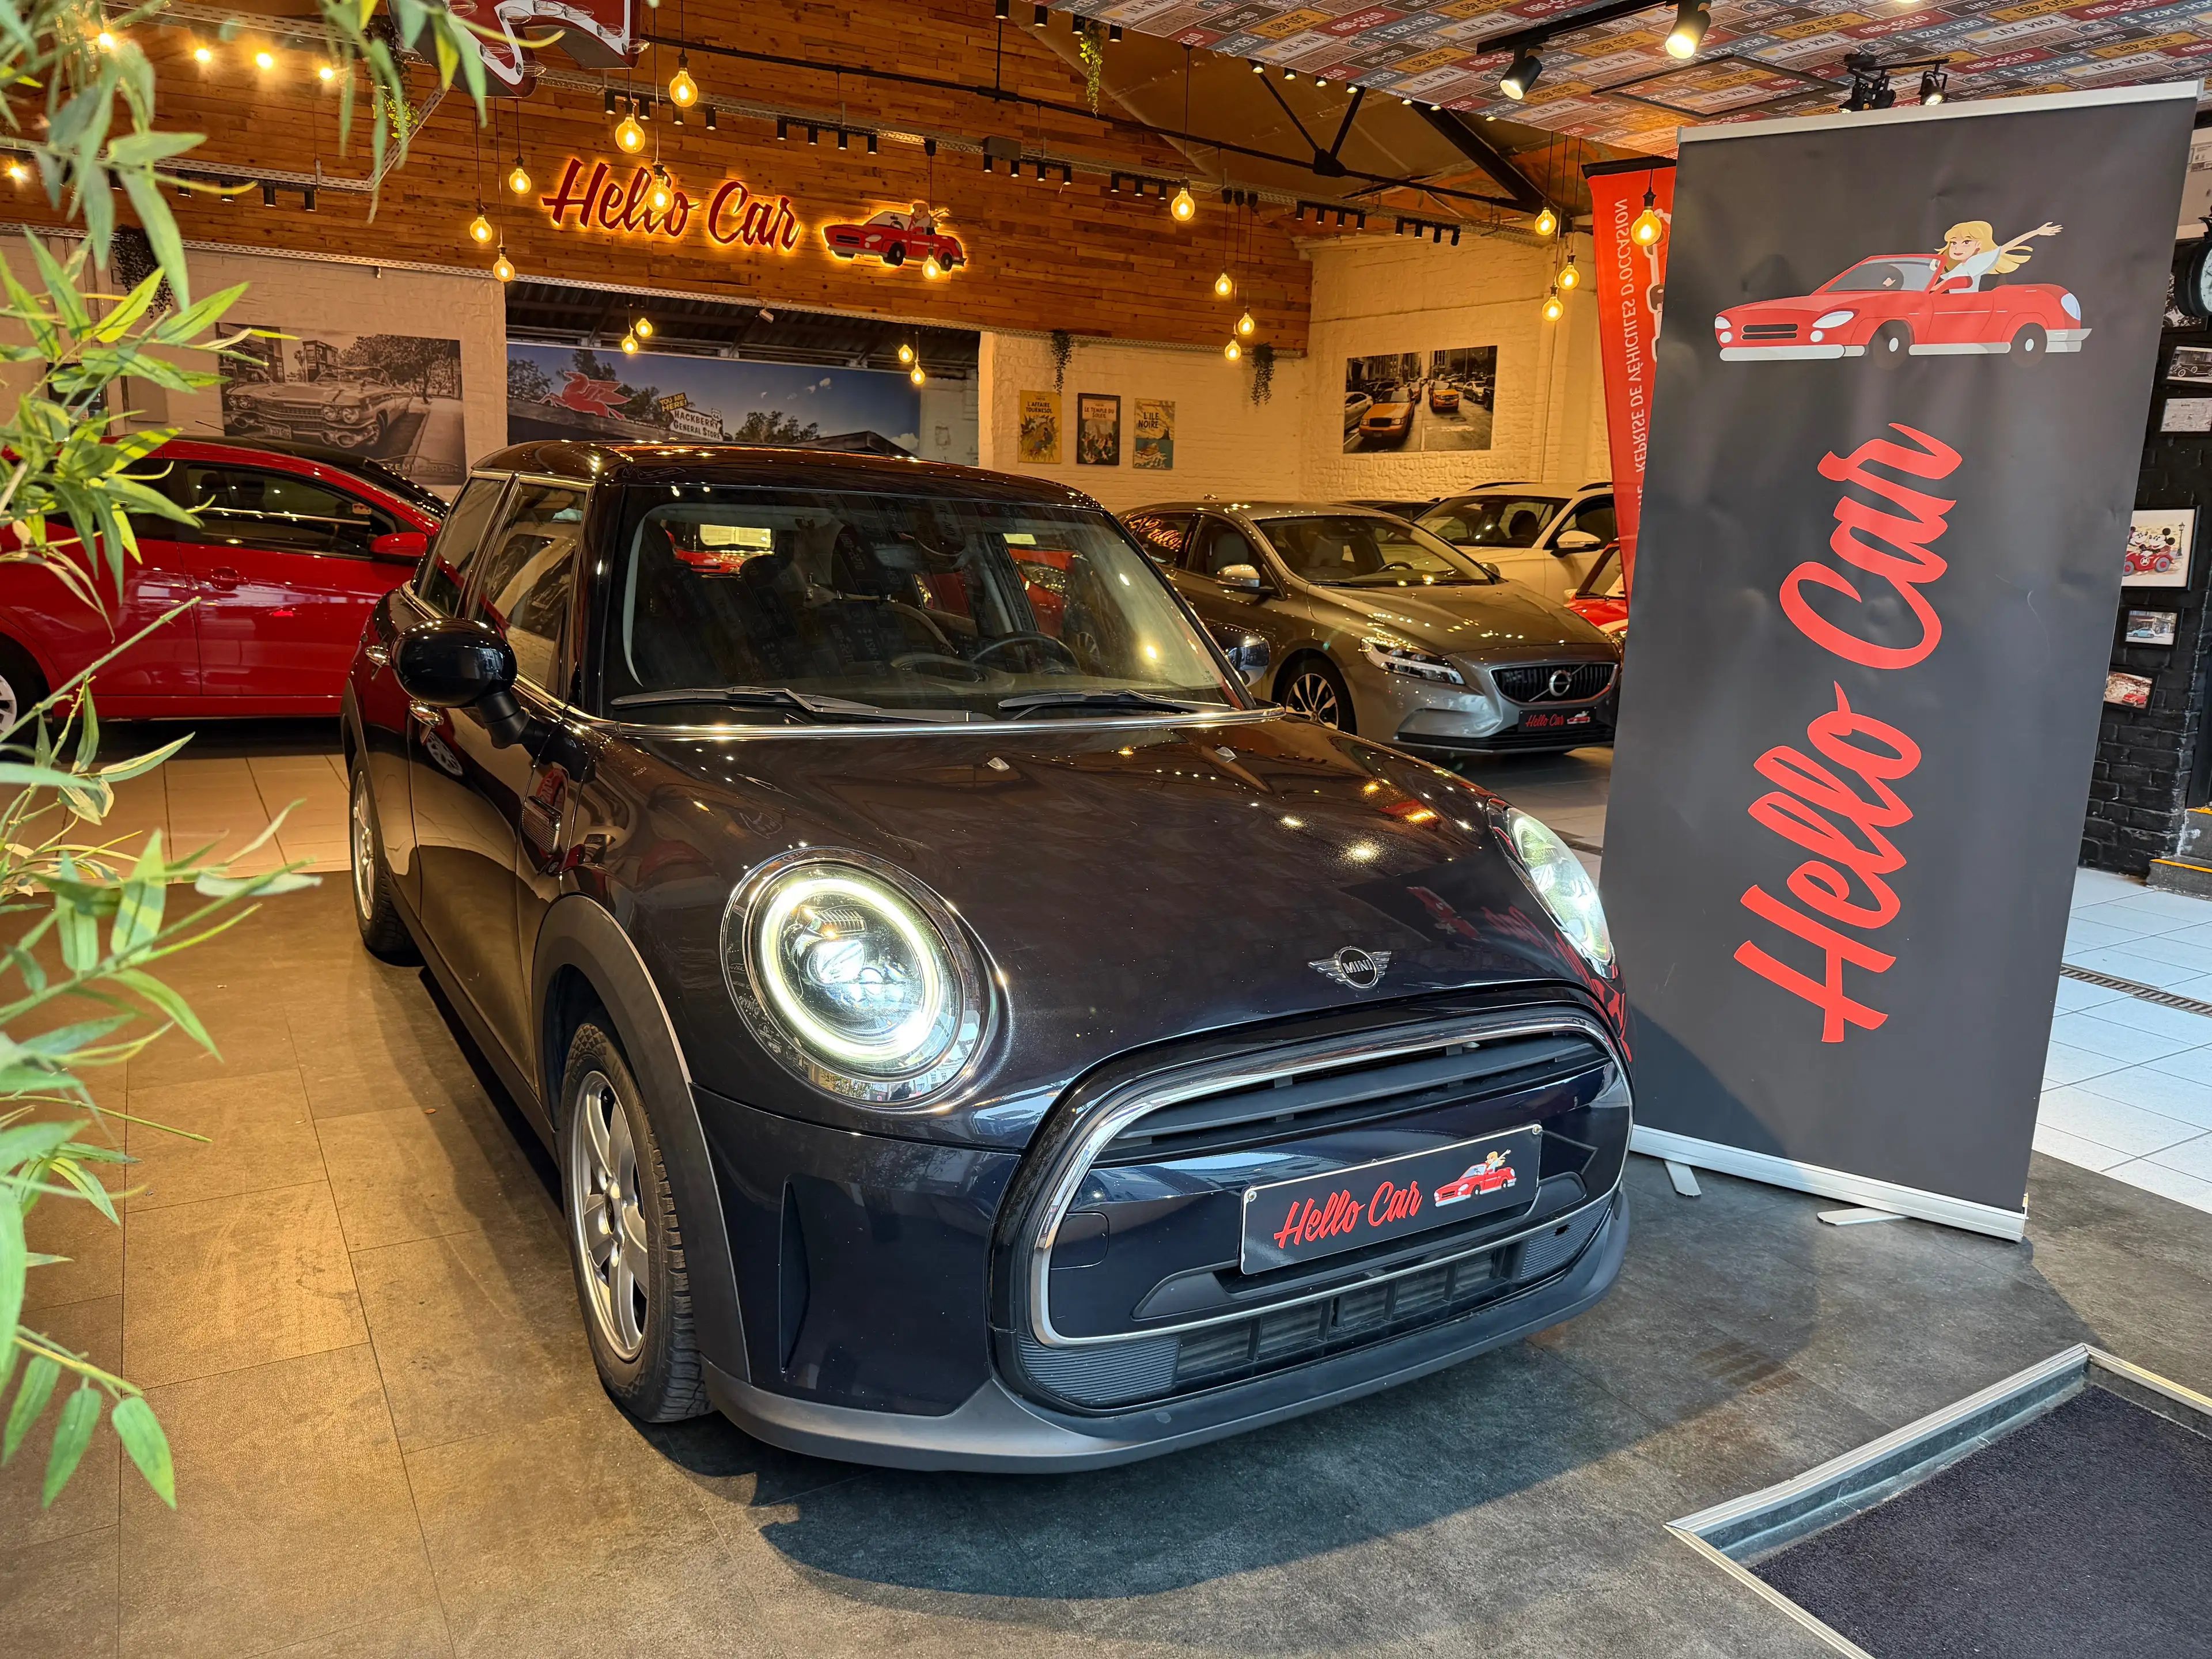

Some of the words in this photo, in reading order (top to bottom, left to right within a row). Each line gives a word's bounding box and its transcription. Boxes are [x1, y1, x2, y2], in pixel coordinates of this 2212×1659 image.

[1990, 18, 2058, 35] KN4-XV1
[541, 158, 699, 236] Hello
[707, 180, 801, 251] Car
[659, 397, 673, 406] YOU
[662, 399, 687, 412] HERE!
[674, 410, 719, 430] HACKBERRY
[1138, 419, 1160, 429] NOIRE
[1779, 422, 1964, 670] Car
[1525, 714, 1550, 728] Hello
[1549, 713, 1565, 727] Car
[1733, 680, 1922, 1044] Hello
[1342, 959, 1373, 974] MINI
[1273, 1188, 1365, 1249] Hello
[1367, 1180, 1423, 1228] Car
